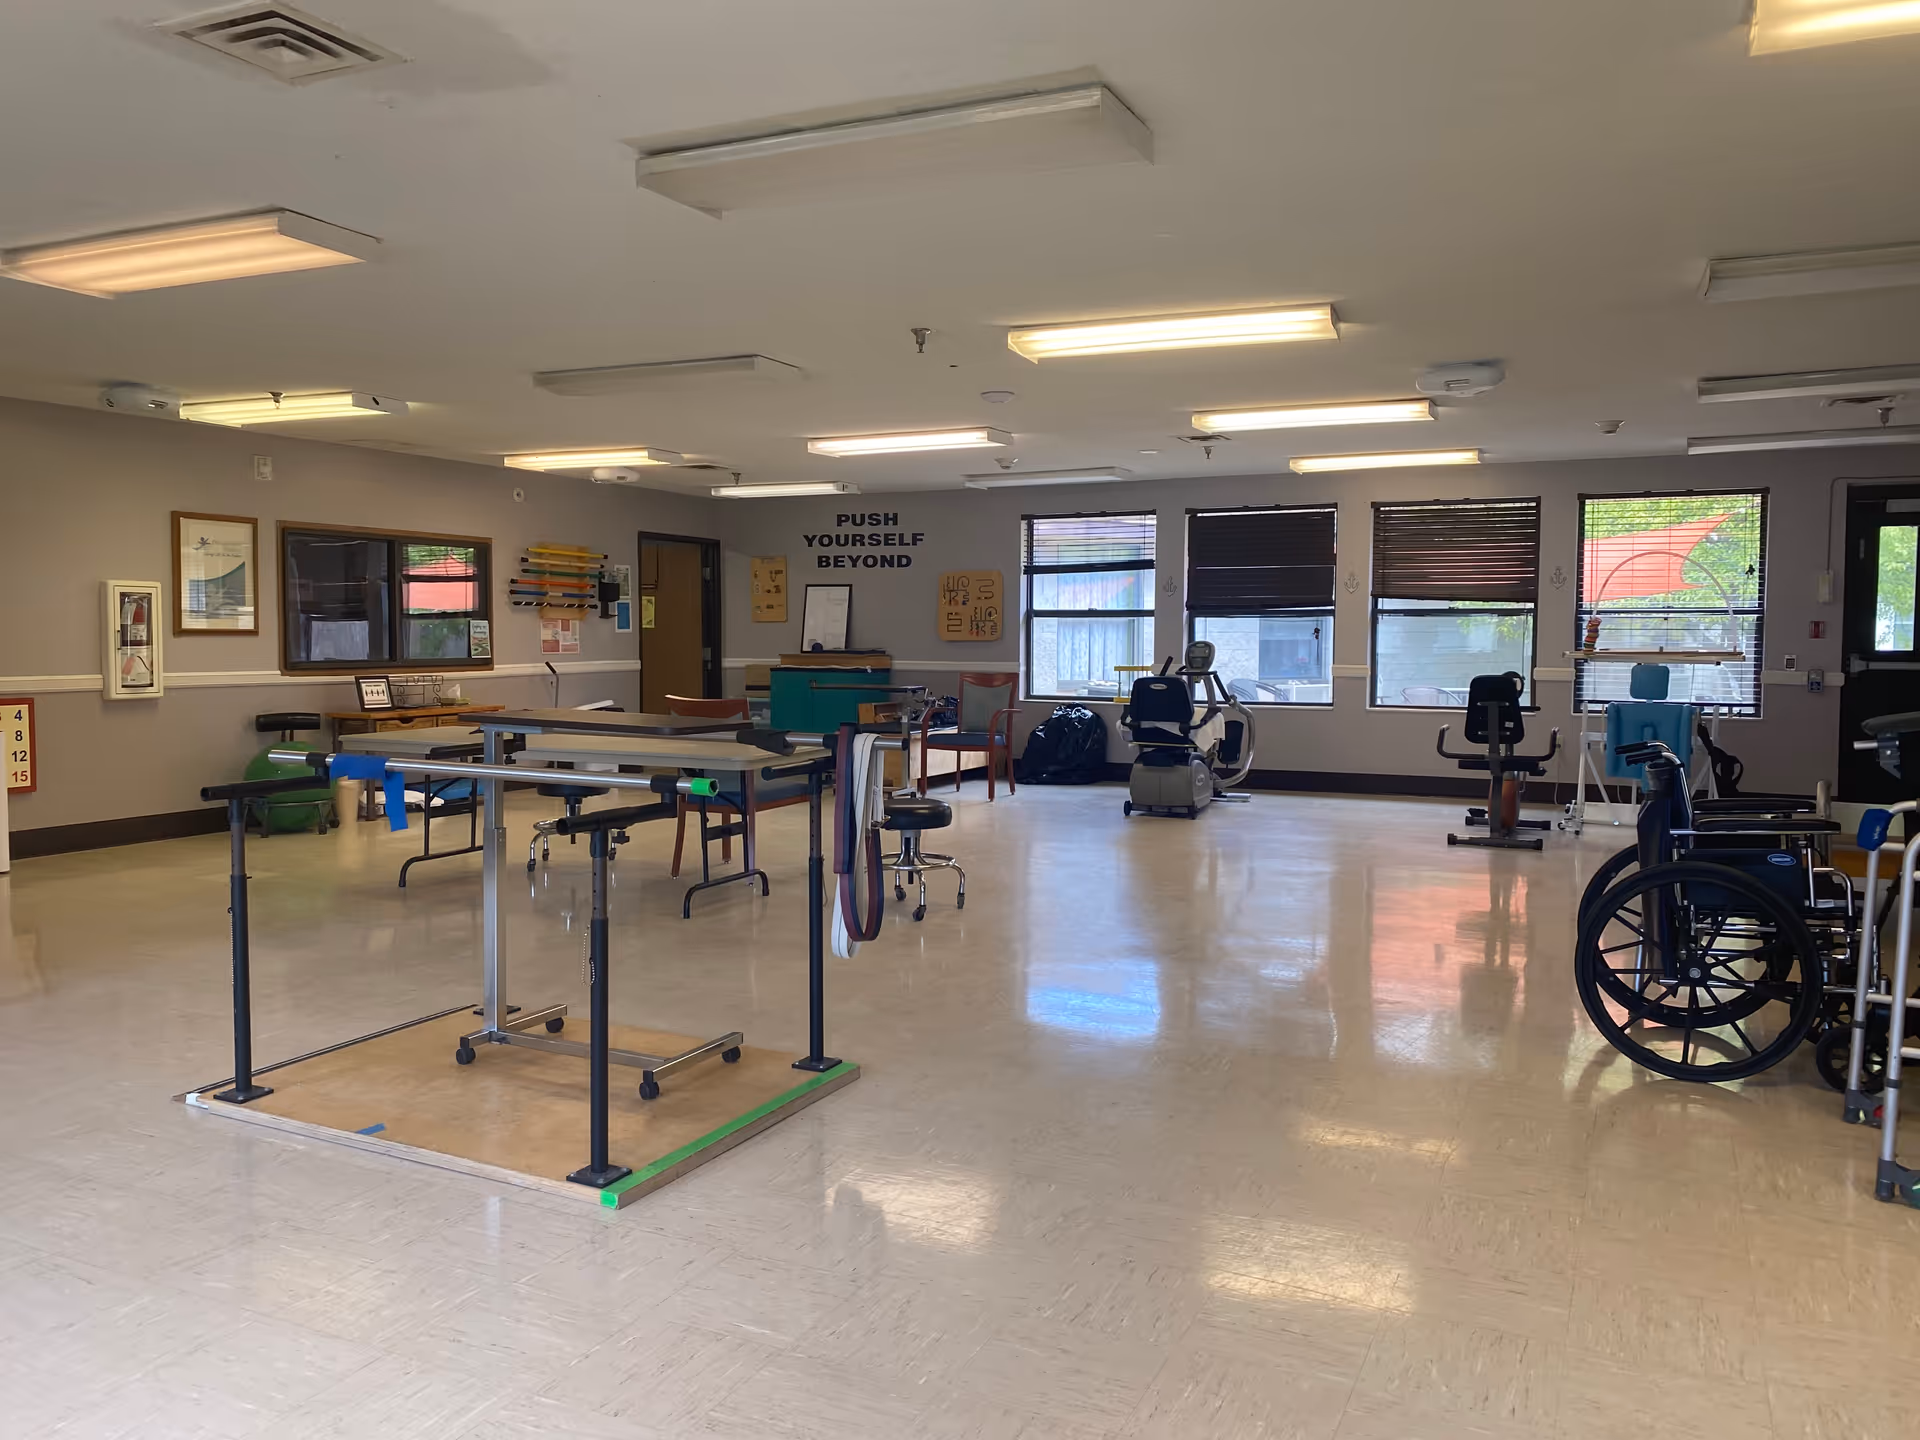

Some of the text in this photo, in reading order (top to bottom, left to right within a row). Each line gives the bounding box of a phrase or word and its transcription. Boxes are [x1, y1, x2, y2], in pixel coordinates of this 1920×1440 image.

[836, 512, 898, 527] PUSH
[802, 532, 925, 547] YOURSELF
[817, 554, 912, 568] BEYOND
[14, 709, 23, 721] 4
[15, 730, 23, 742] 8
[11, 750, 28, 762] 12
[11, 770, 28, 783] 15
